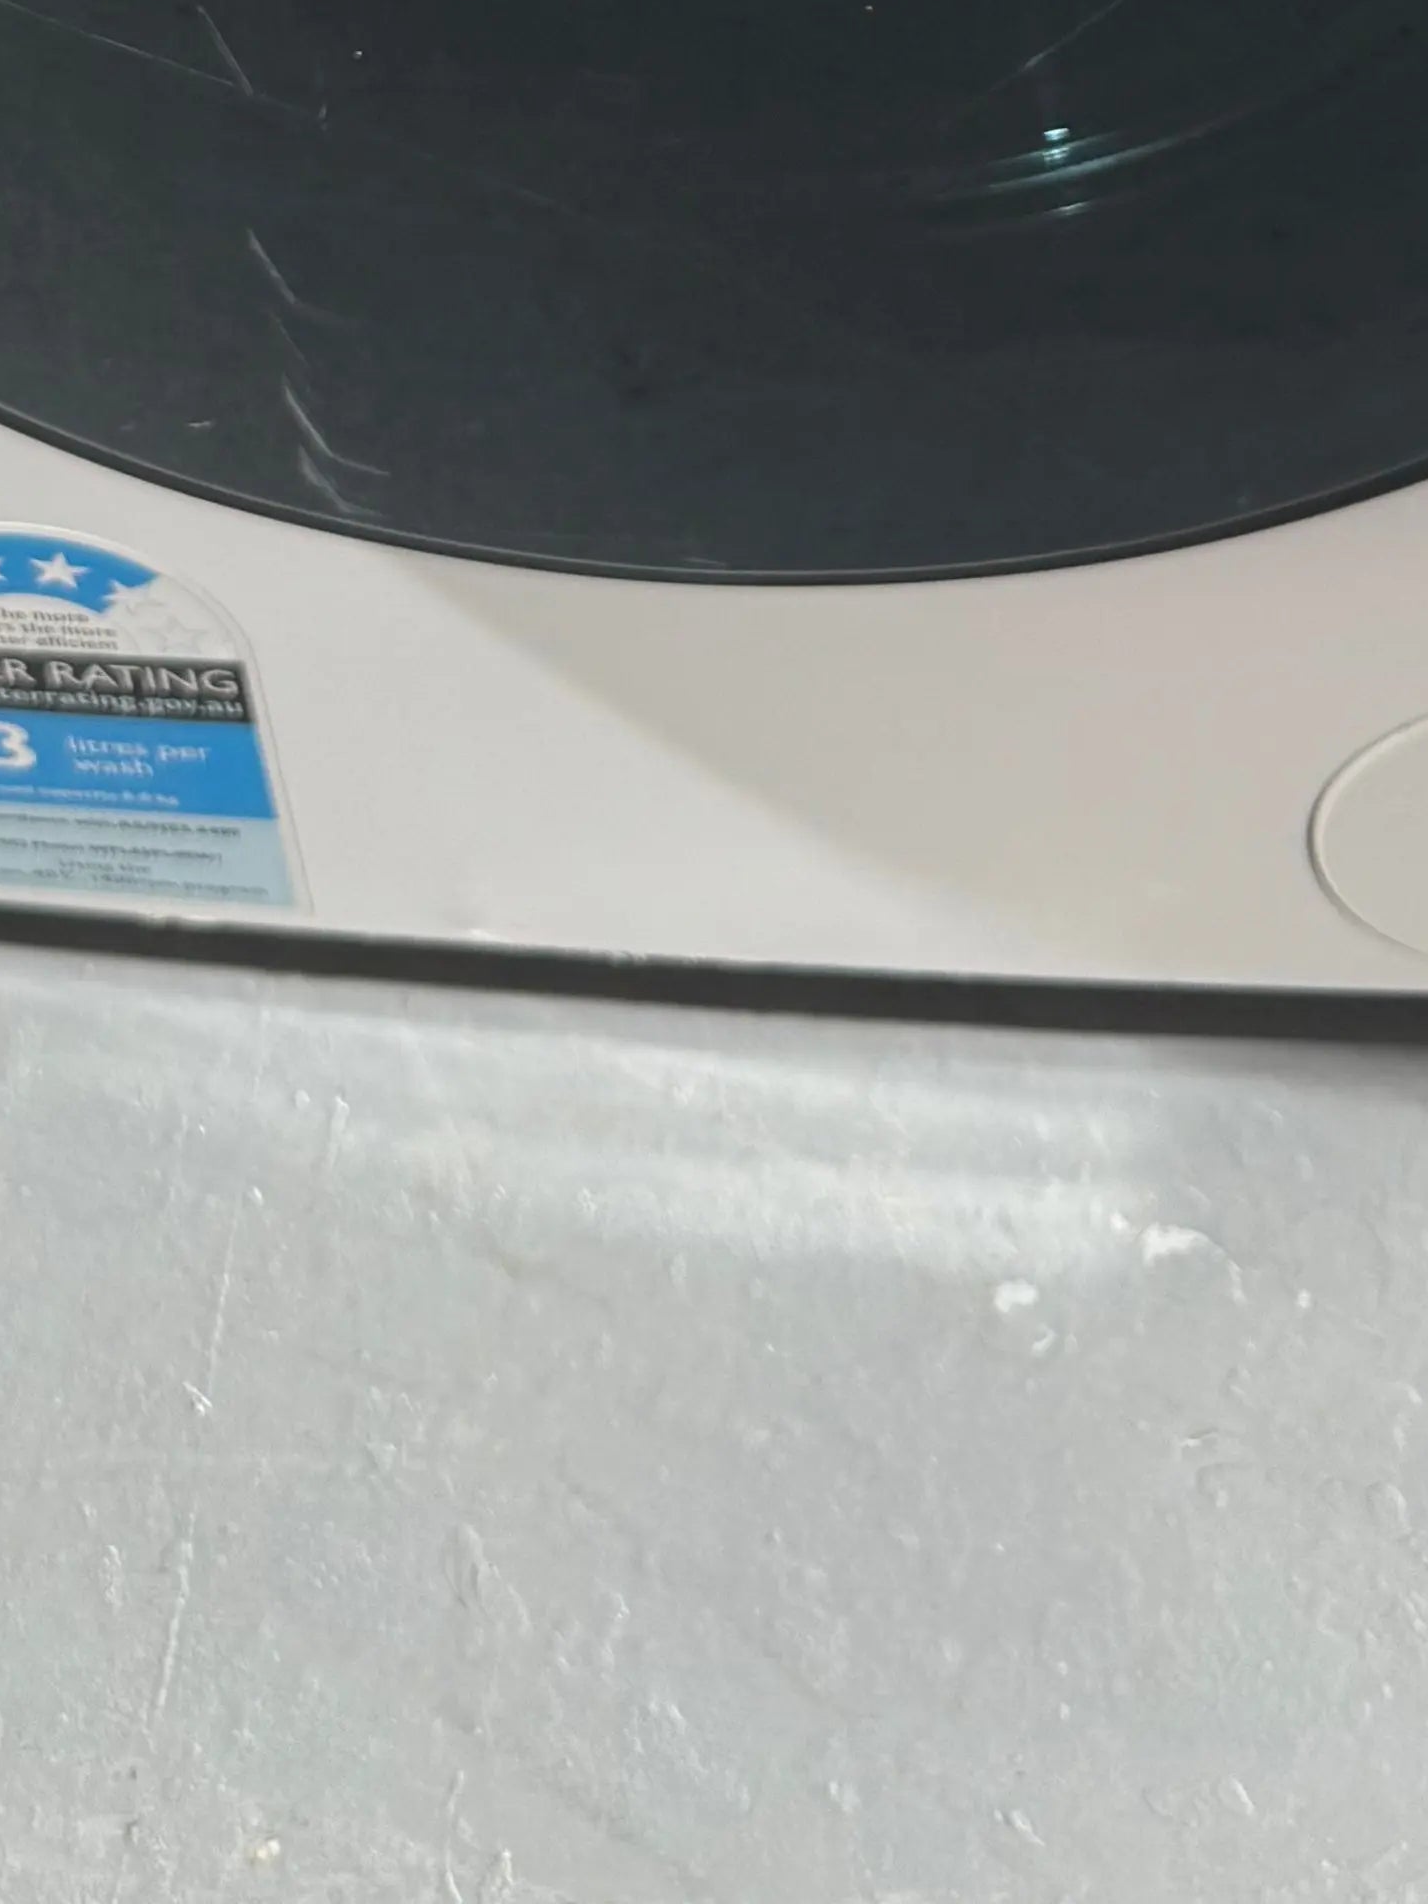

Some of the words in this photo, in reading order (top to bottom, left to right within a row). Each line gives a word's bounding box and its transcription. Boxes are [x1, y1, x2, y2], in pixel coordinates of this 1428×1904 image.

[44, 660, 240, 695] RATING
[67, 736, 151, 757] litres
[157, 742, 211, 764] per
[73, 758, 154, 777] wash
